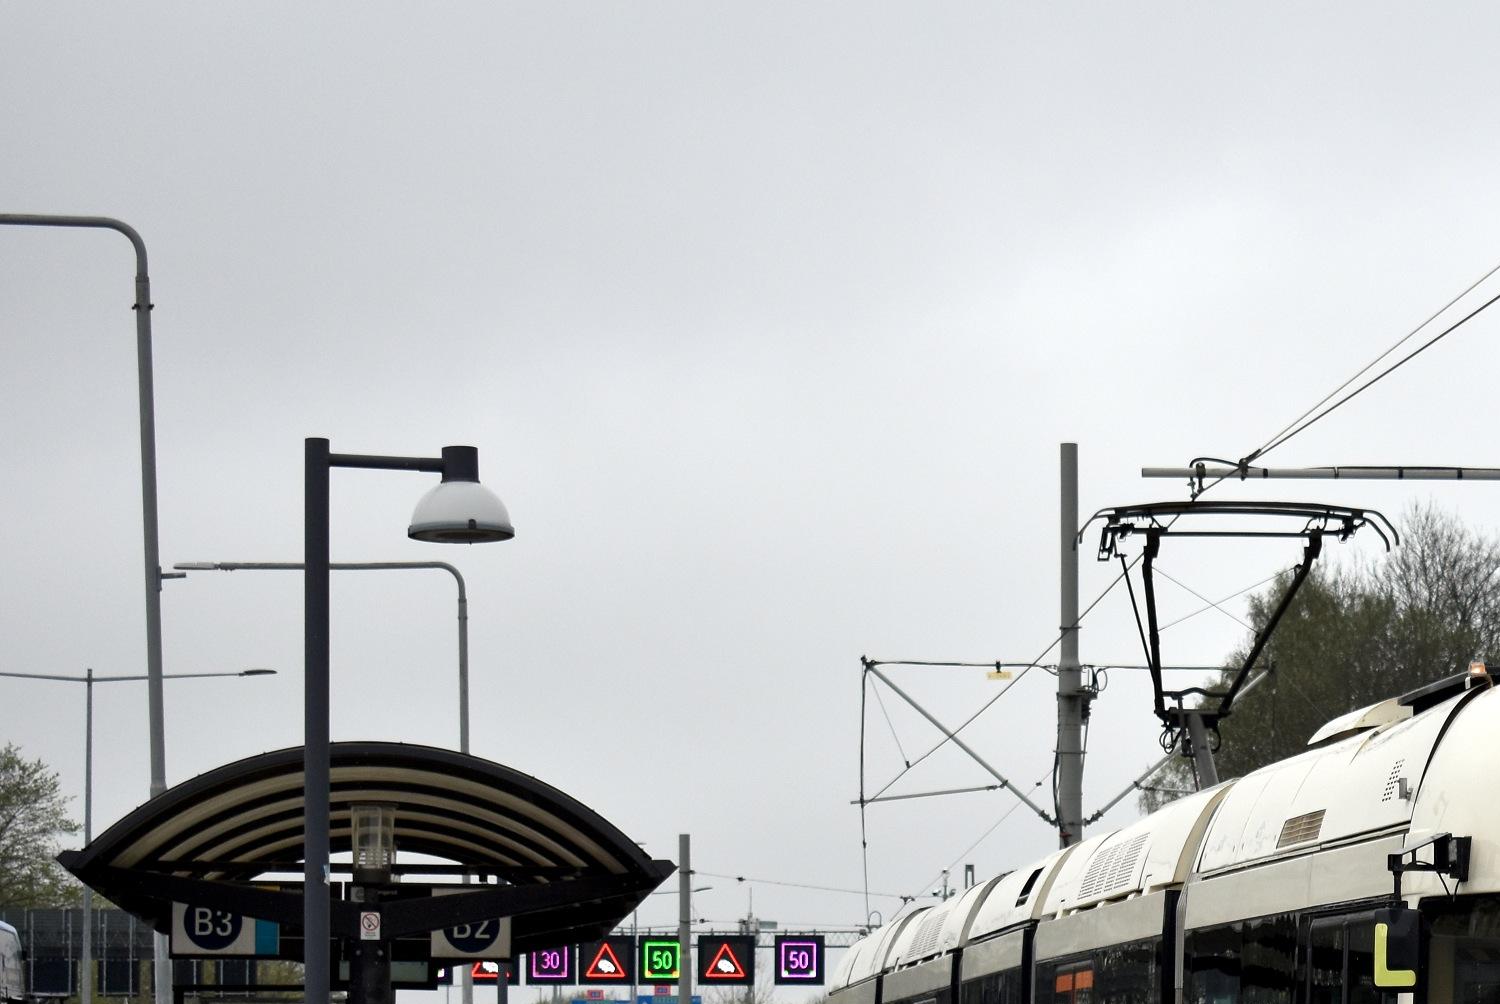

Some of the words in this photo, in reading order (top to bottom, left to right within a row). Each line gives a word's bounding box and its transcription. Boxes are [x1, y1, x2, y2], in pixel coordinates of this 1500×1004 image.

[194, 907, 233, 937] B3
[541, 951, 560, 969] 30
[652, 950, 673, 970] 50
[789, 950, 809, 970] 50
